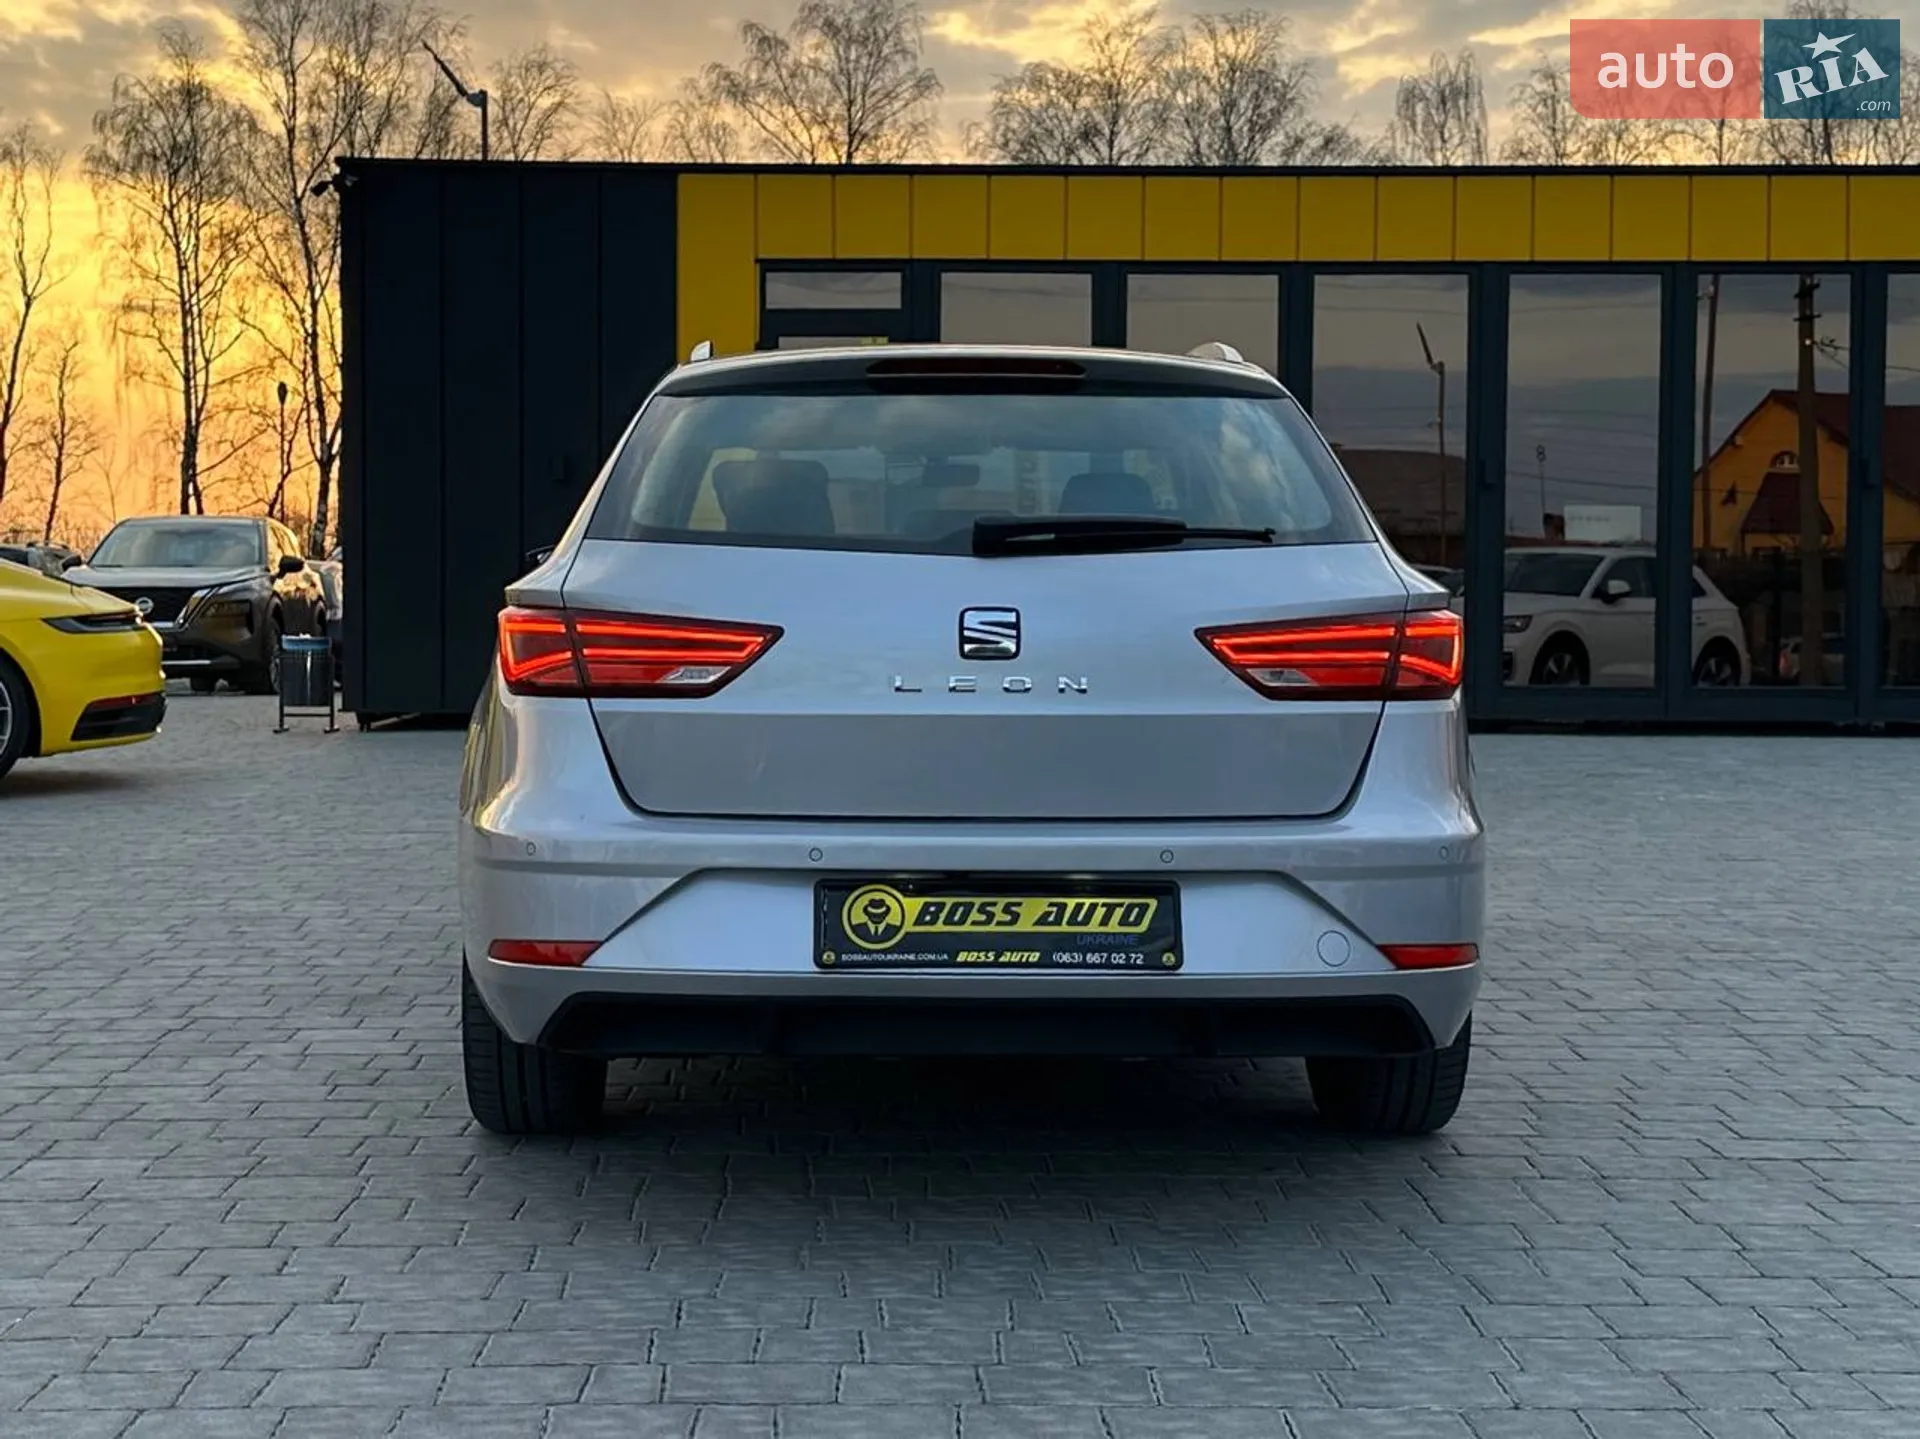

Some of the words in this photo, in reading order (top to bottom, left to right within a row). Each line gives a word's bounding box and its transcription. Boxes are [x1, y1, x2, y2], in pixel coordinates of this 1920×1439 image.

[894, 675, 1088, 693] LEON
[912, 901, 1024, 927] BOSS
[1032, 901, 1151, 927] AUTO
[1076, 934, 1140, 946] UKRAINE
[956, 951, 996, 962] BOSS
[999, 951, 1041, 962] AUTO
[1052, 952, 1083, 963] (063)
[1086, 952, 1108, 964] 667
[1111, 953, 1126, 964] 02
[1129, 953, 1145, 964] 72
